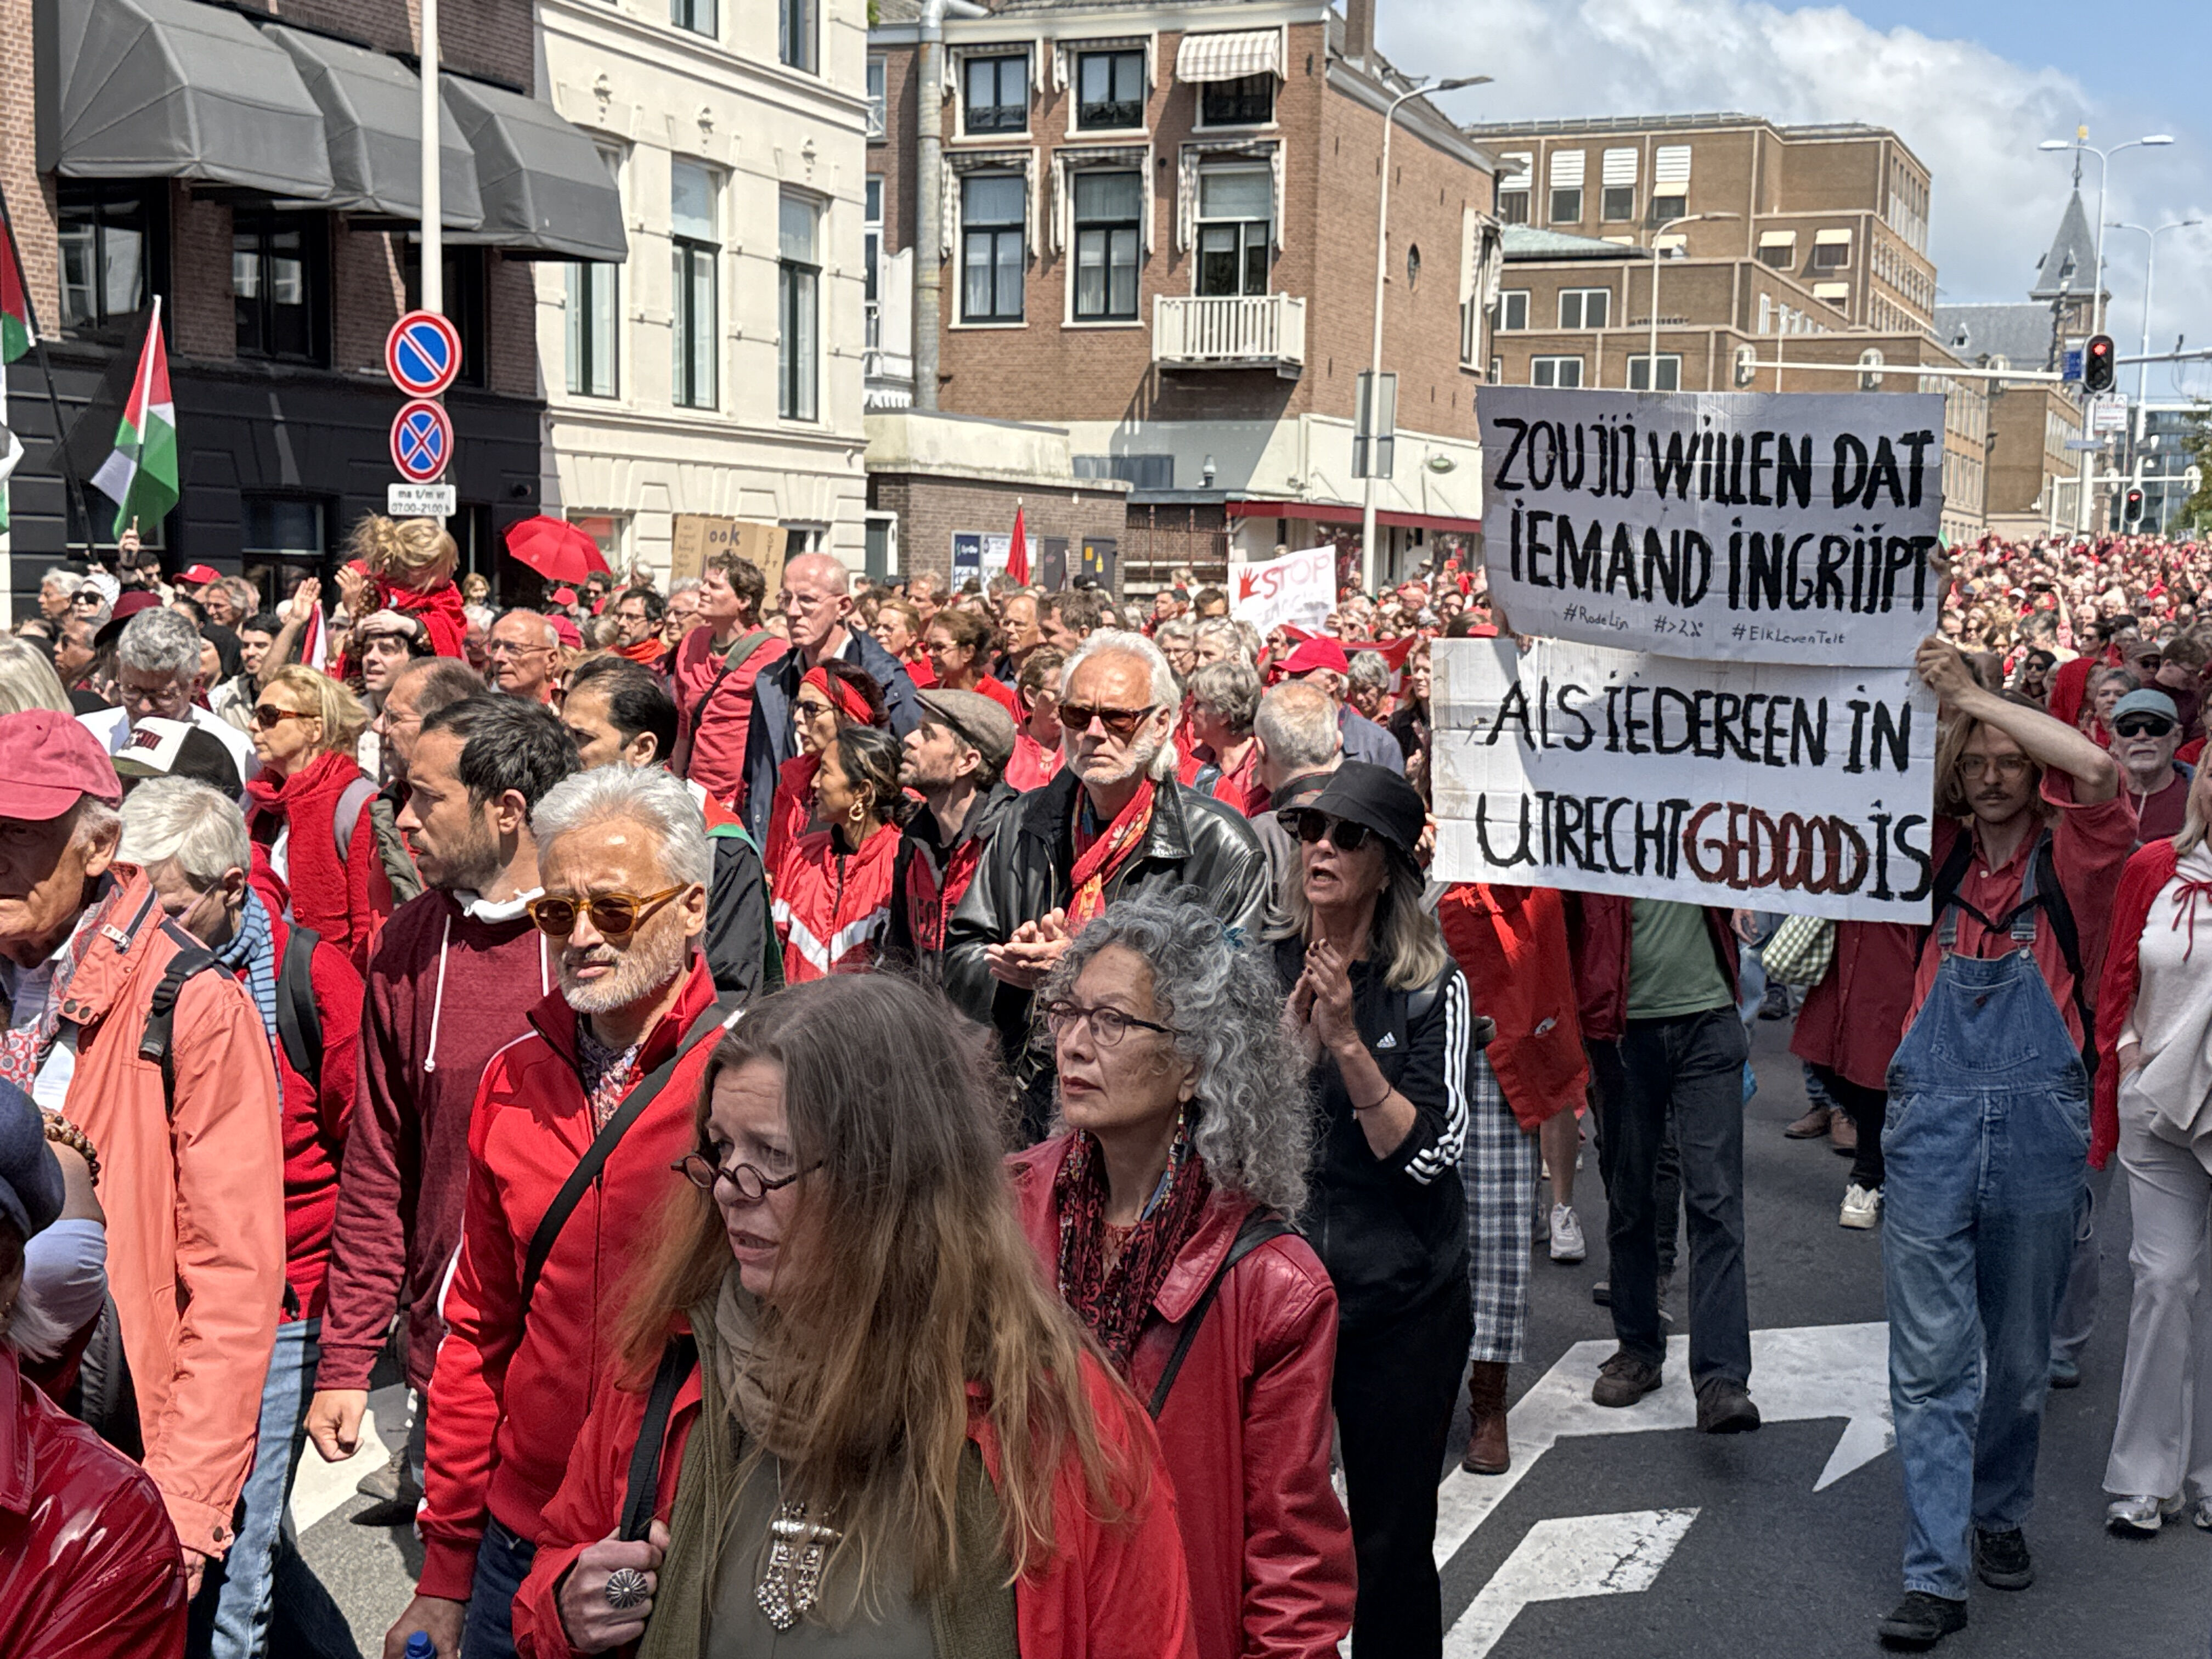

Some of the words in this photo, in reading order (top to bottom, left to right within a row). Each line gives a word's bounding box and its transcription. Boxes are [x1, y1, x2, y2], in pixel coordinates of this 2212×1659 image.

[1493, 417, 1584, 491] ZOU
[1832, 430, 1936, 509] DAT
[709, 524, 740, 546] ook
[1262, 554, 1331, 600] STOP
[1481, 675, 1595, 752] ALS
[1603, 670, 1828, 766] IEDEREEN
[1842, 684, 1911, 774] IN
[1475, 790, 1693, 879] UTRECHT
[1681, 801, 1867, 895] GEDOOD
[1866, 799, 1932, 902] IS
